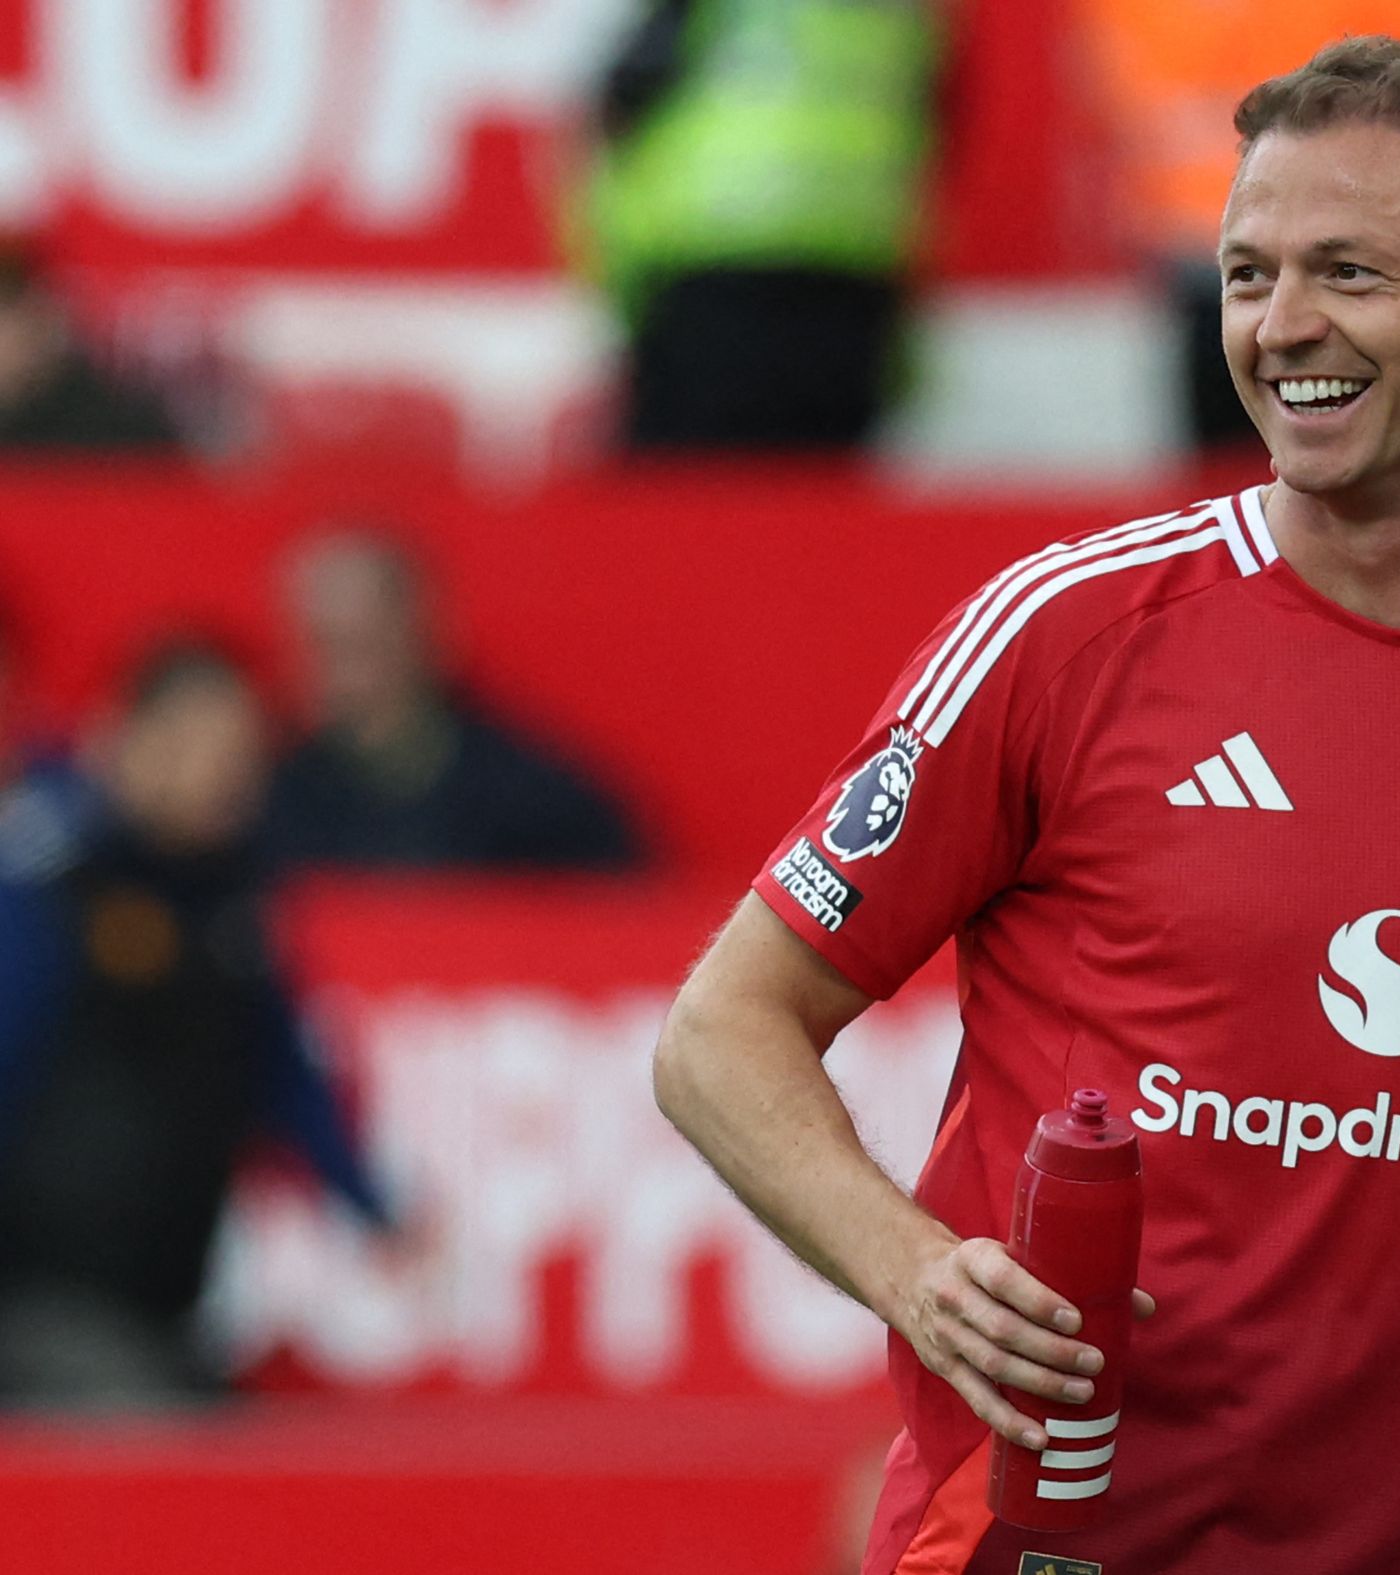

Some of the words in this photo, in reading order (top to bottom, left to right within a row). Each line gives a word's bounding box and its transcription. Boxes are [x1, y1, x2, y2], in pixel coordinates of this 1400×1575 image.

[771, 855, 797, 881] for
[790, 836, 811, 867] No
[800, 855, 848, 907] room
[783, 872, 843, 932] racism
